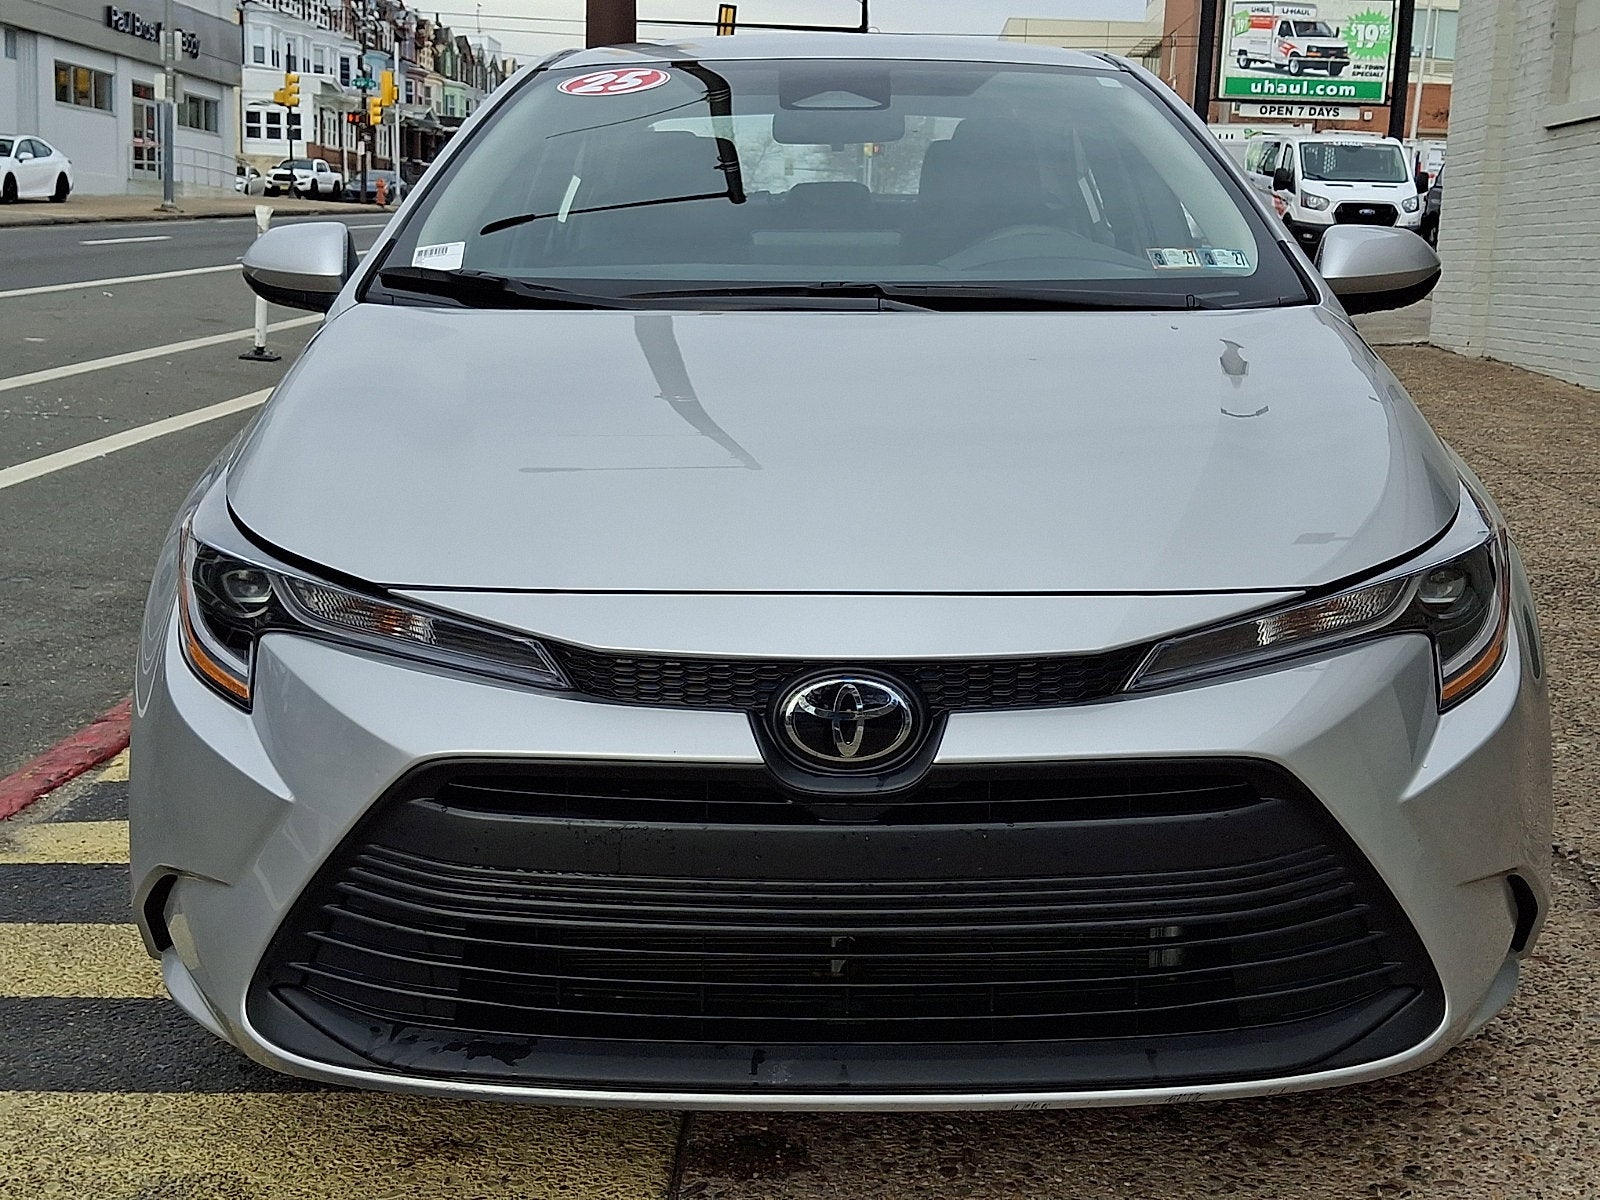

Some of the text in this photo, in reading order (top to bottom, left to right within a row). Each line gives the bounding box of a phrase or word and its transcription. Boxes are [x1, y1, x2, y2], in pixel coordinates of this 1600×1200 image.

[106, 5, 131, 33] Paul
[571, 70, 653, 93] 25
[1250, 80, 1356, 96] uhaul.com
[1259, 105, 1340, 118] OPEN 7 DAYS
